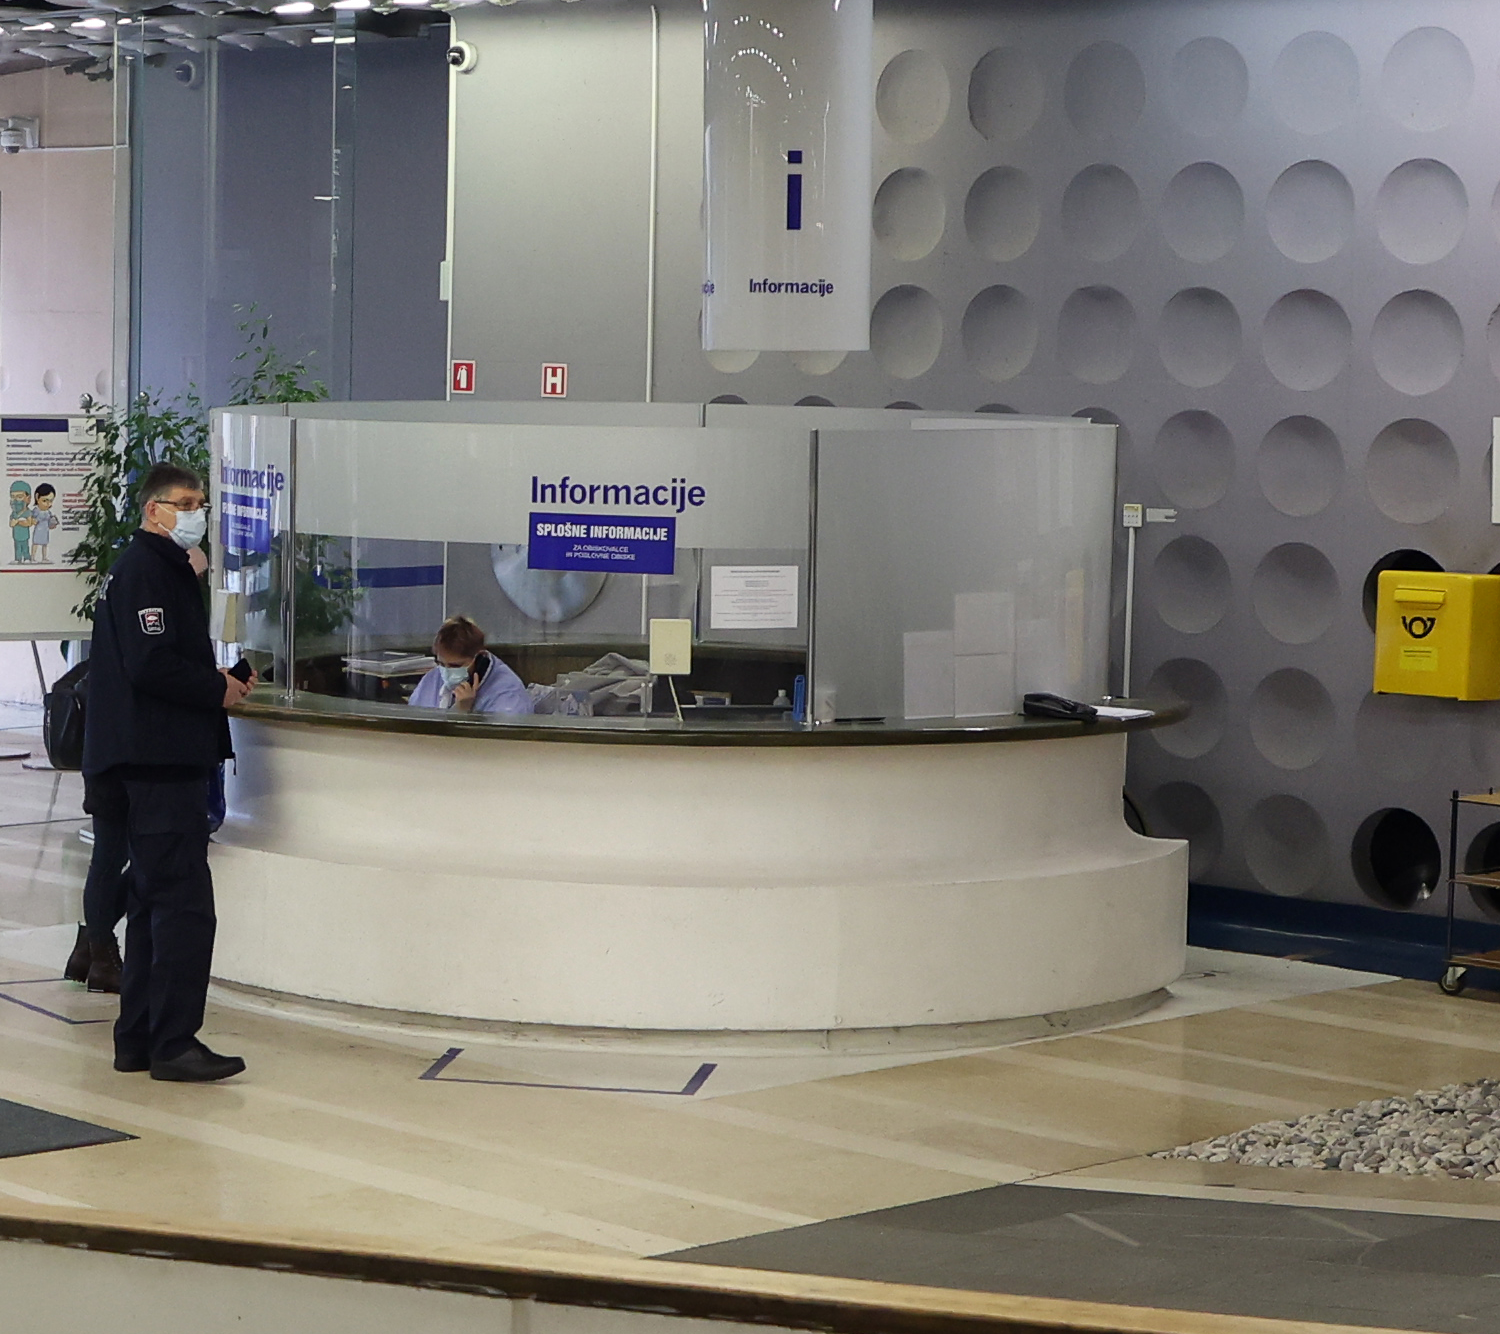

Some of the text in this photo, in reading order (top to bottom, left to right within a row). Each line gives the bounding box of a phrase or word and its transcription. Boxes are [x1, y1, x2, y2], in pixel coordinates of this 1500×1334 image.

[749, 278, 834, 297] Informacije
[531, 475, 706, 513] Informacije
[536, 522, 668, 541] SPLOŠNE INFORMACIJE
